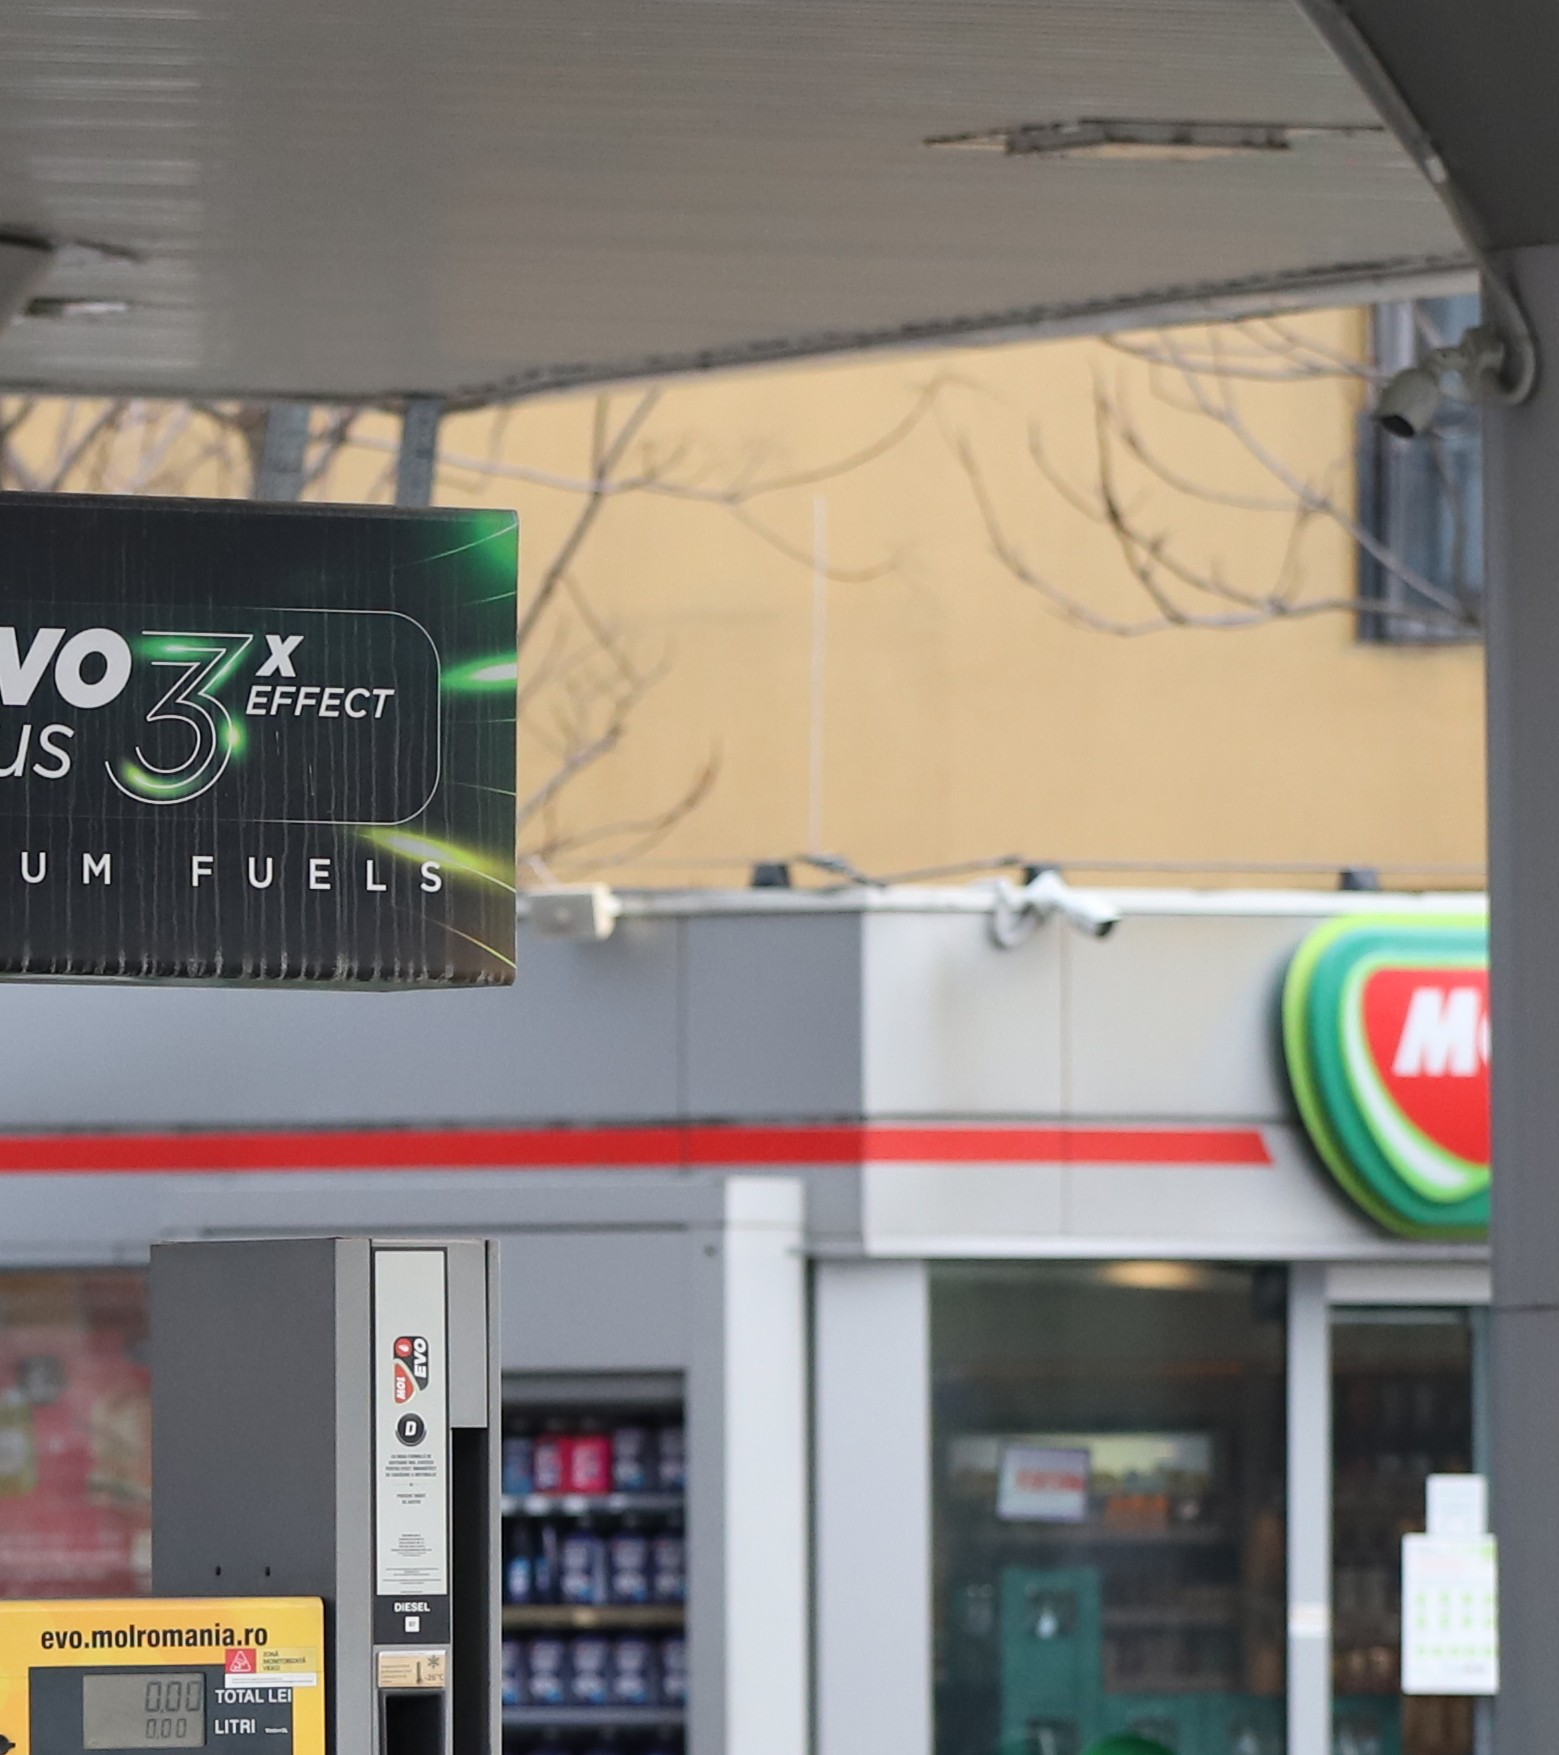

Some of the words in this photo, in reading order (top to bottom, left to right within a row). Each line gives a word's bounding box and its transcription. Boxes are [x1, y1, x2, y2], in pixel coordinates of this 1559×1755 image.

[244, 684, 395, 721] EFFECT
[190, 854, 444, 894] FUELS
[413, 1337, 428, 1379] EVO
[396, 1376, 407, 1400] MOL
[404, 1420, 418, 1437] D
[393, 1602, 431, 1613] DIESEL
[40, 1623, 268, 1650] evo.molromania.ro
[215, 1689, 264, 1704] TOTAL
[268, 1688, 292, 1703] LEI
[214, 1718, 256, 1735] LITRI
